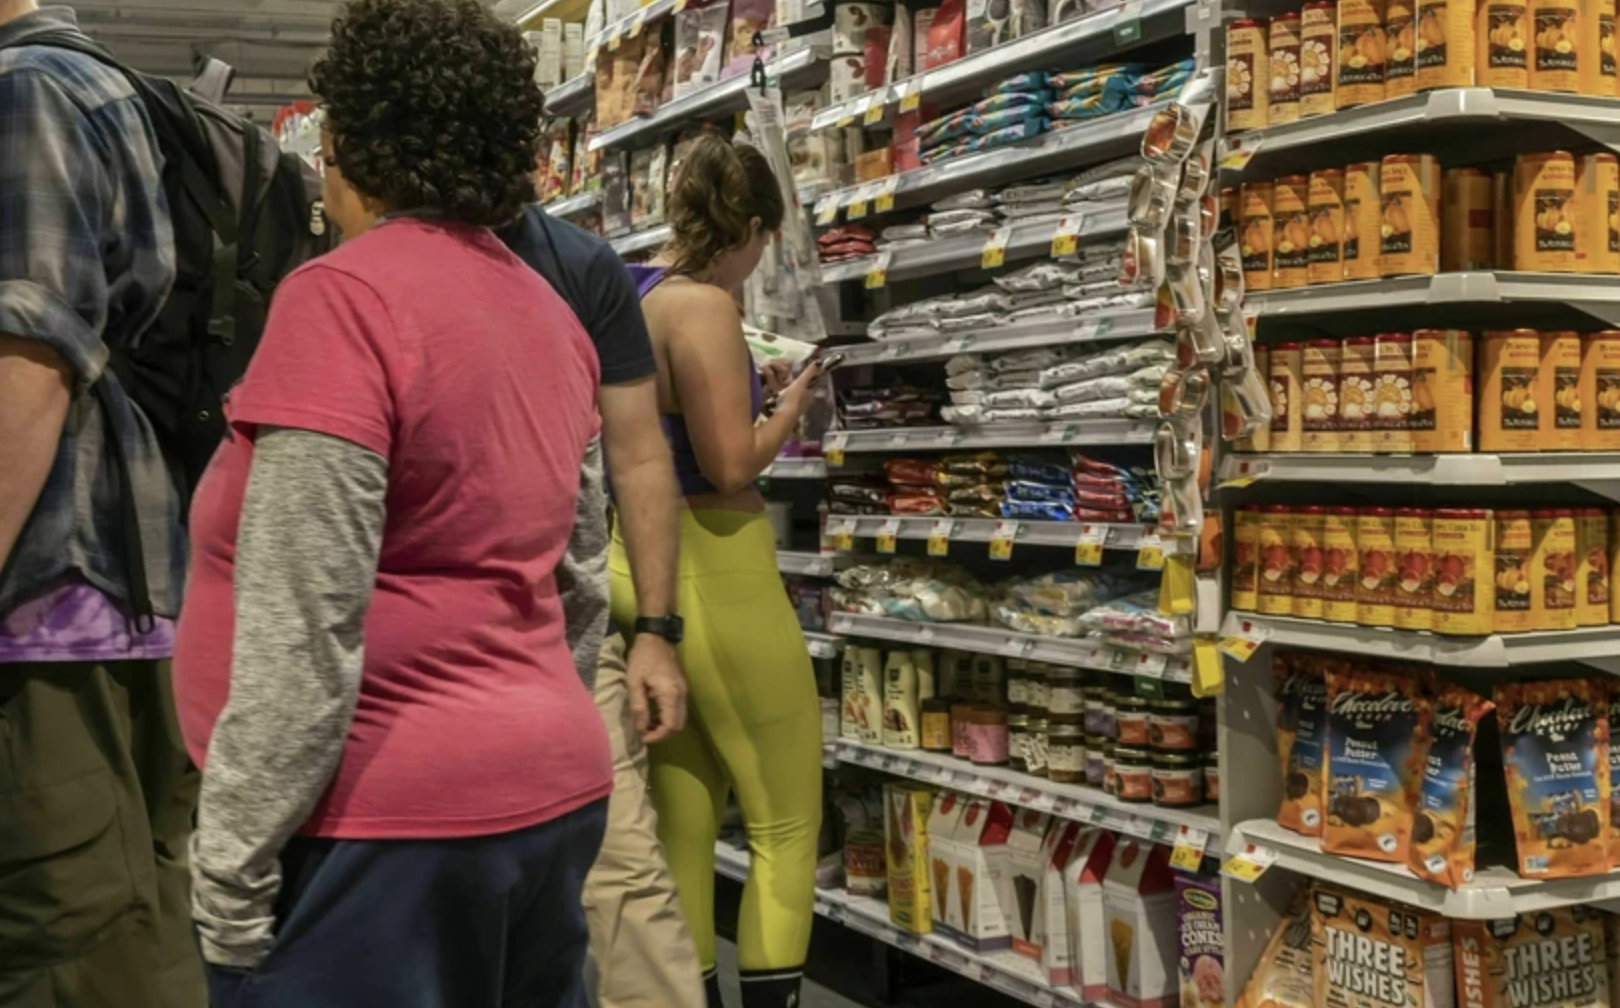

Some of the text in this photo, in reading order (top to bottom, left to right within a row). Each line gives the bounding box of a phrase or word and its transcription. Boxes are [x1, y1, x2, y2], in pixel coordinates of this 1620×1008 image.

[1182, 929, 1224, 948] CONES
[1325, 926, 1405, 977] THREE
[1503, 932, 1593, 979] THREE
[1327, 958, 1405, 1006] WISHES
[1507, 966, 1596, 1008] WISHES
